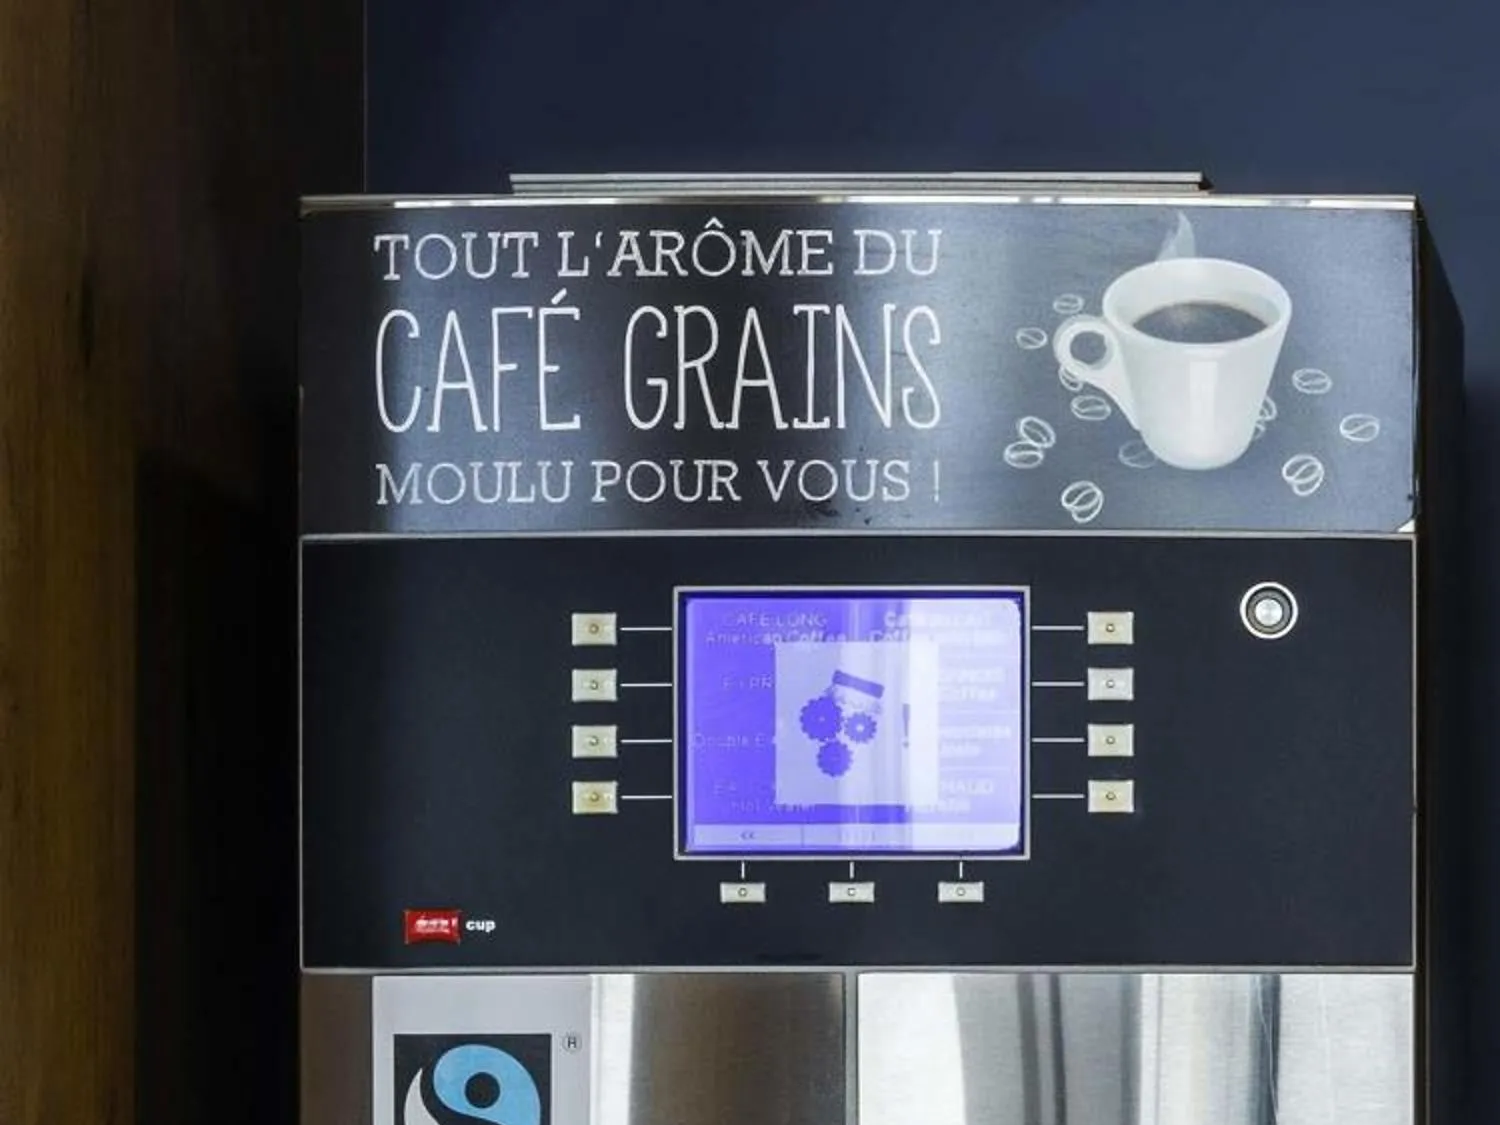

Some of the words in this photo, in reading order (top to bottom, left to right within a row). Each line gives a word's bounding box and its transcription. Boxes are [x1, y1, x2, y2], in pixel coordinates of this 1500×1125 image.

[374, 233, 539, 280] TOUT
[853, 230, 942, 276] DU
[375, 288, 581, 433] CAFÉ
[623, 303, 942, 431] GRAINS
[375, 462, 575, 505] MOULU
[591, 461, 740, 504] POUR
[757, 461, 911, 503] VOUS
[465, 918, 496, 933] cup
